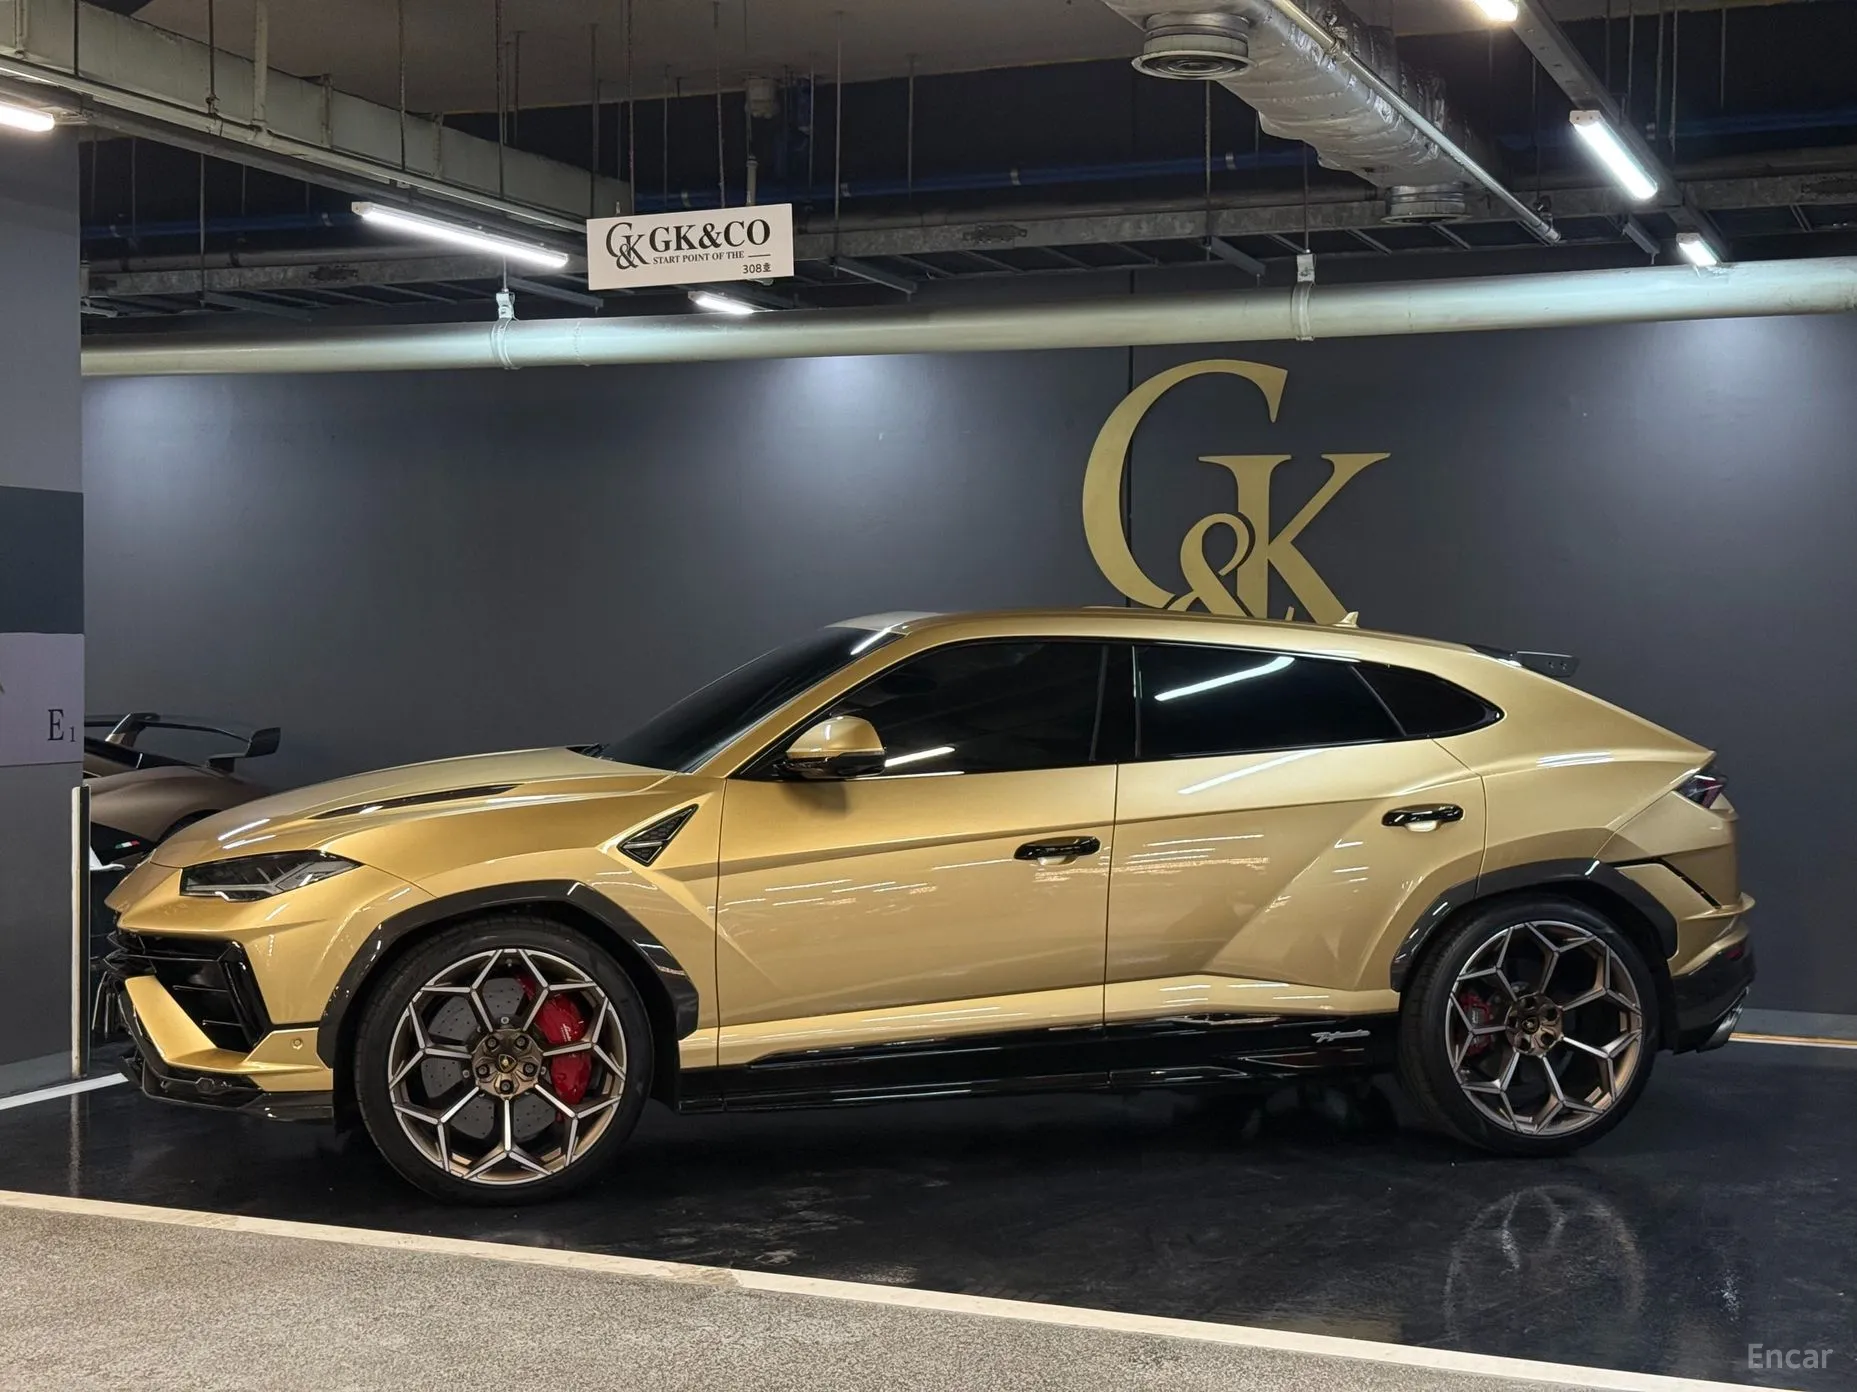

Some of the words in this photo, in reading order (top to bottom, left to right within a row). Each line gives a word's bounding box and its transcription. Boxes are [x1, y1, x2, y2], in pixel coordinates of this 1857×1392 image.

[649, 218, 771, 253] GK&CO
[652, 254, 680, 265] START
[682, 252, 710, 263] POINT
[711, 251, 725, 261] OF
[725, 250, 745, 260] THE
[742, 262, 772, 274] 308호
